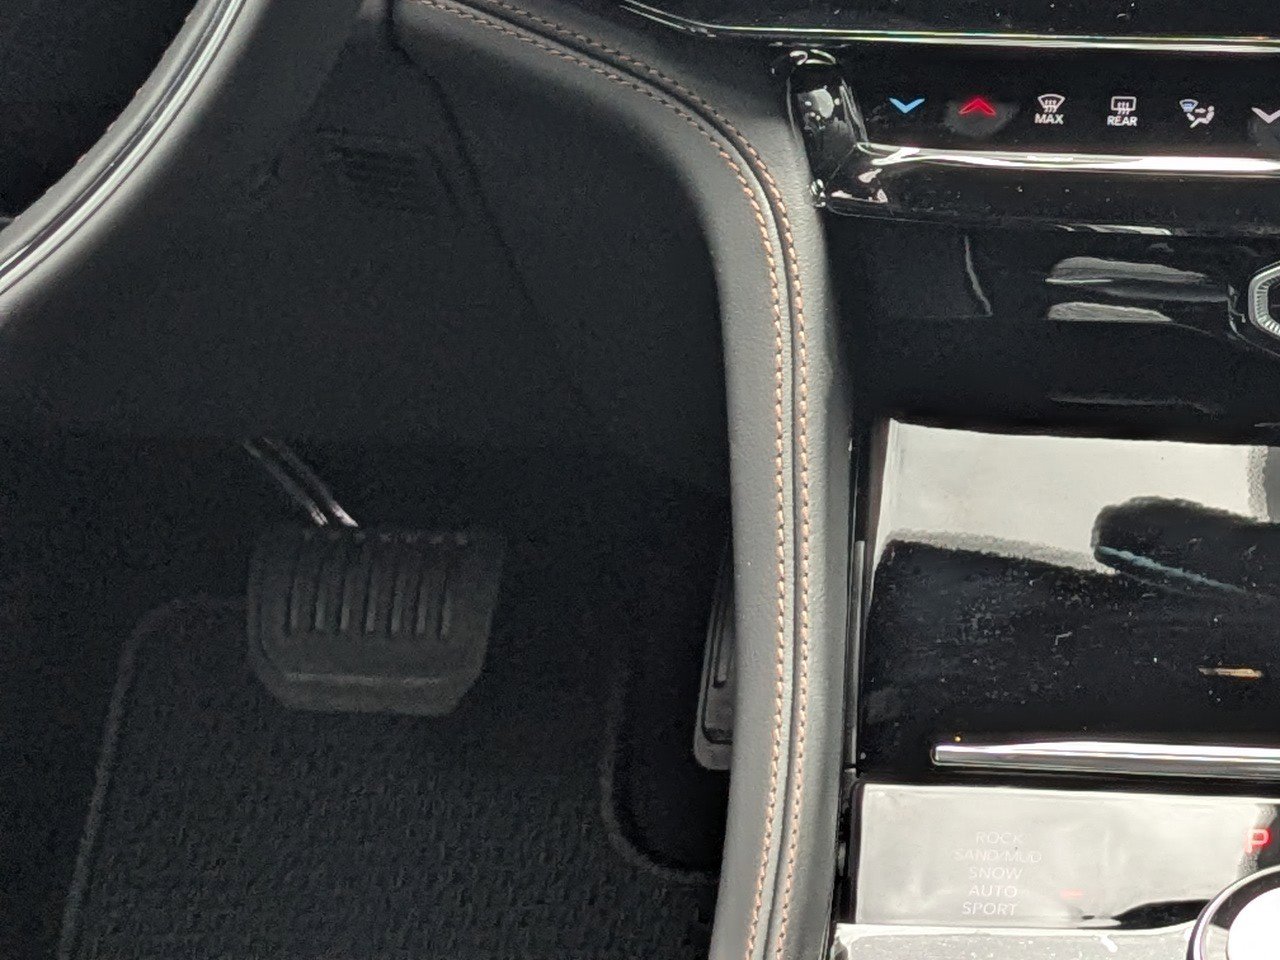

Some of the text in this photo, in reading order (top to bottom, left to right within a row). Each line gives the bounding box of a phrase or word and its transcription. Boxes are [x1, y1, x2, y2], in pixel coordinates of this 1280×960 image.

[1035, 113, 1064, 125] MAX
[1107, 115, 1138, 127] REAR
[976, 831, 1023, 844] ROCK
[1245, 830, 1269, 854] P
[968, 867, 1023, 880] SNOW
[968, 884, 1018, 898] AUTO
[962, 901, 1019, 916] SPORT
